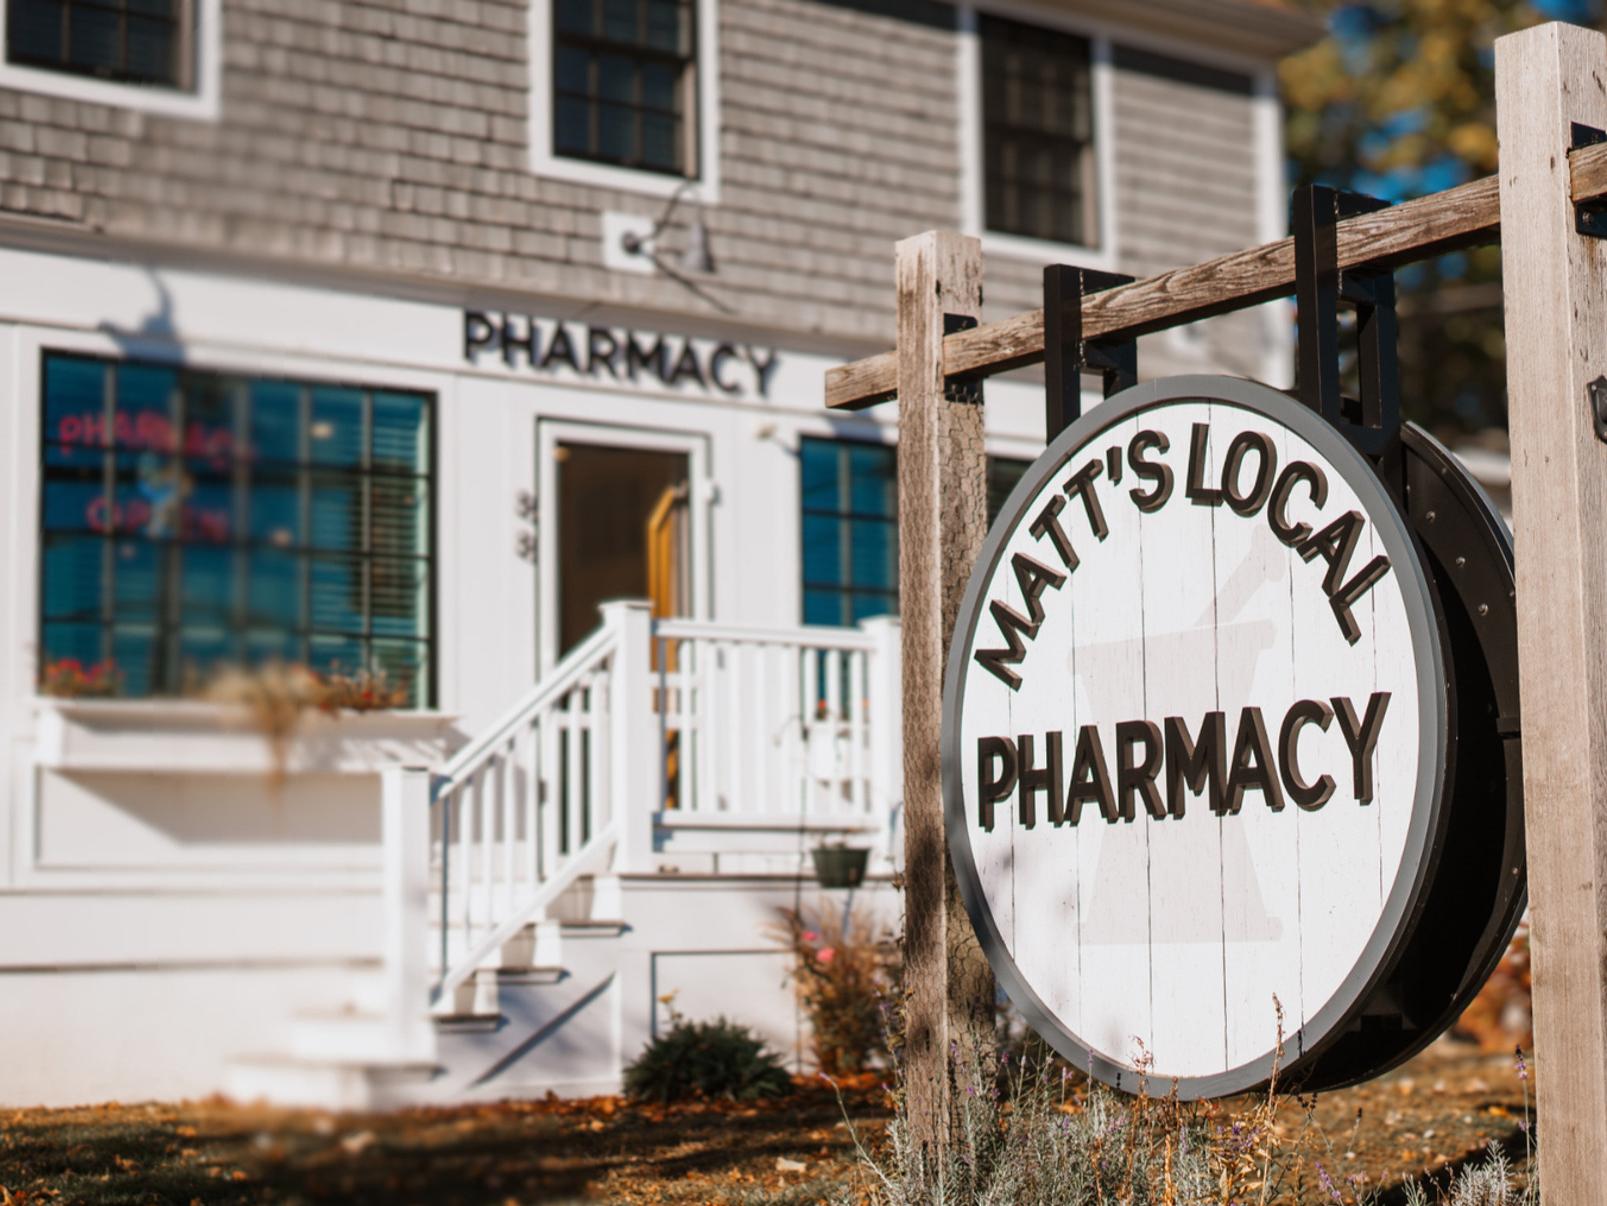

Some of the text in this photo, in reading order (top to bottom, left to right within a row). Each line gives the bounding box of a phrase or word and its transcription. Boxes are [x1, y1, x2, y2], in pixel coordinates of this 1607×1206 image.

[463, 309, 779, 397] PHARMACY
[974, 422, 1392, 692] MATT'S LOCAL
[977, 691, 1392, 832] PHARMACY
